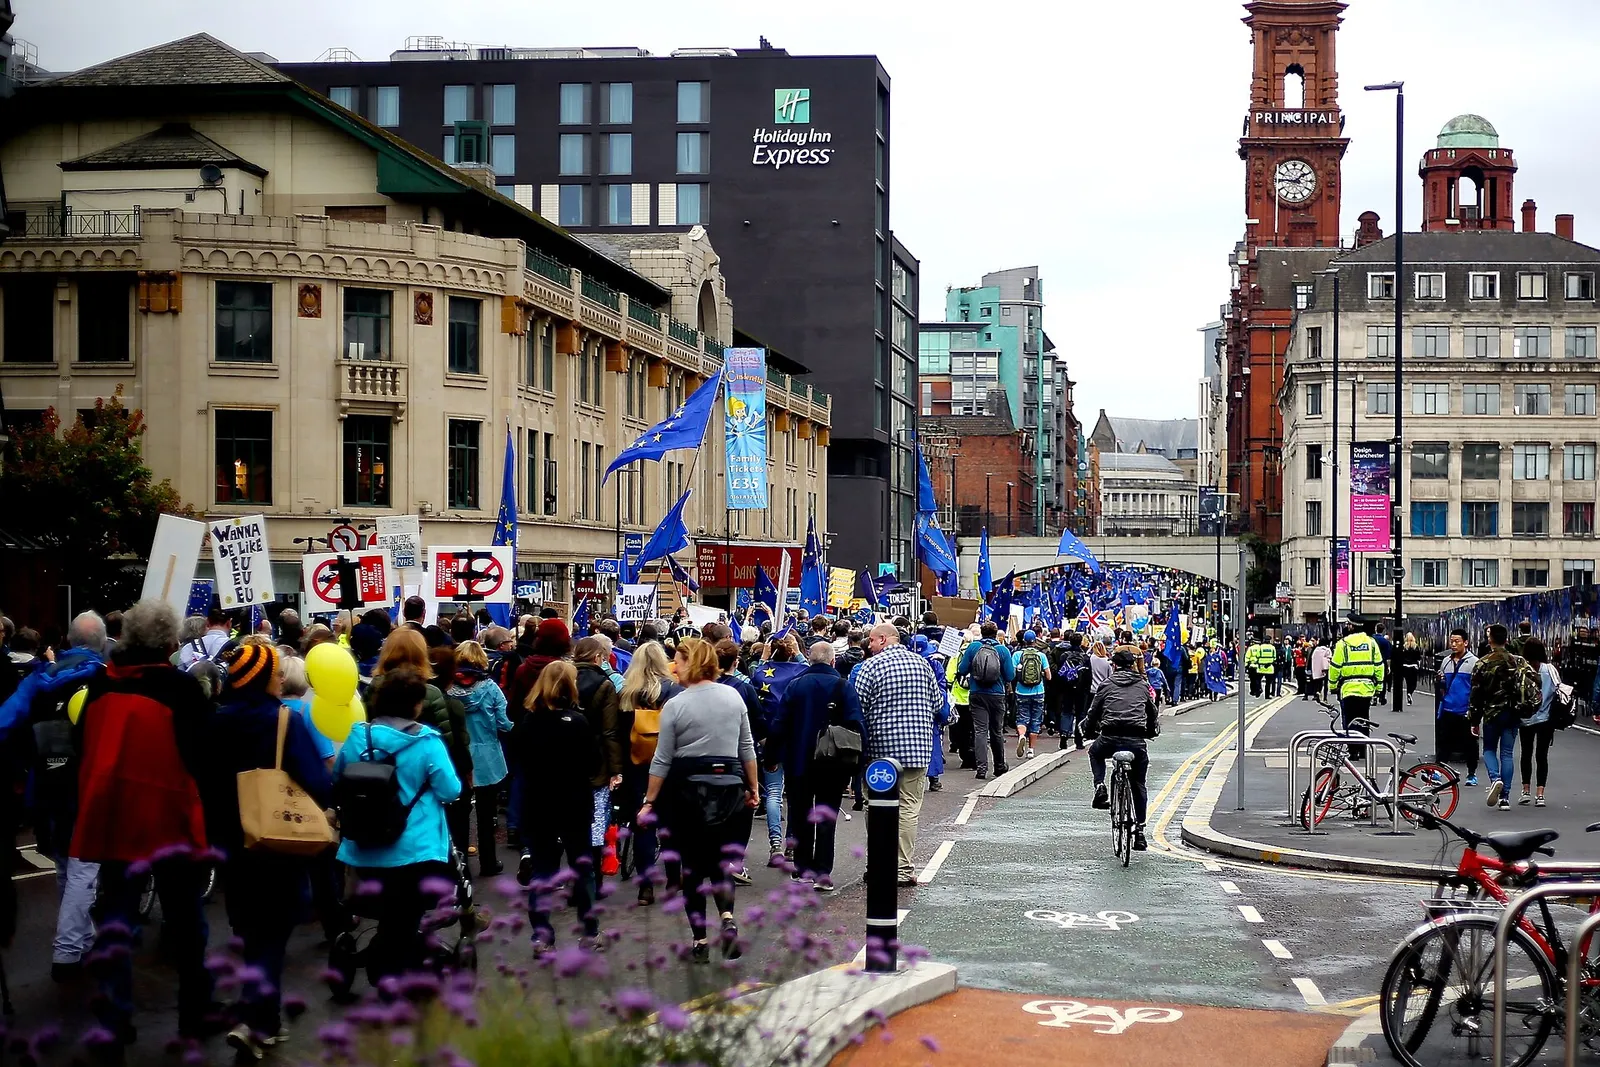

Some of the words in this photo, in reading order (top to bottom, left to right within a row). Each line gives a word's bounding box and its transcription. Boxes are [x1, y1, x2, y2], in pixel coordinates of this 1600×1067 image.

[1255, 112, 1336, 123] PRINCIPAL
[752, 128, 807, 146] Holiday
[808, 127, 832, 143] Inn
[752, 144, 831, 170] Express
[731, 455, 761, 464] Family
[730, 465, 764, 473] Tickets
[732, 477, 760, 489] £35
[211, 523, 261, 543] WANNA
[218, 543, 235, 559] BE
[397, 558, 414, 566] NHS
[451, 562, 458, 572] DO
[362, 583, 369, 593] DO
[595, 573, 610, 594] KFC
[235, 586, 254, 603] EU
[888, 592, 910, 604] TORIES
[890, 604, 910, 616] OUT
